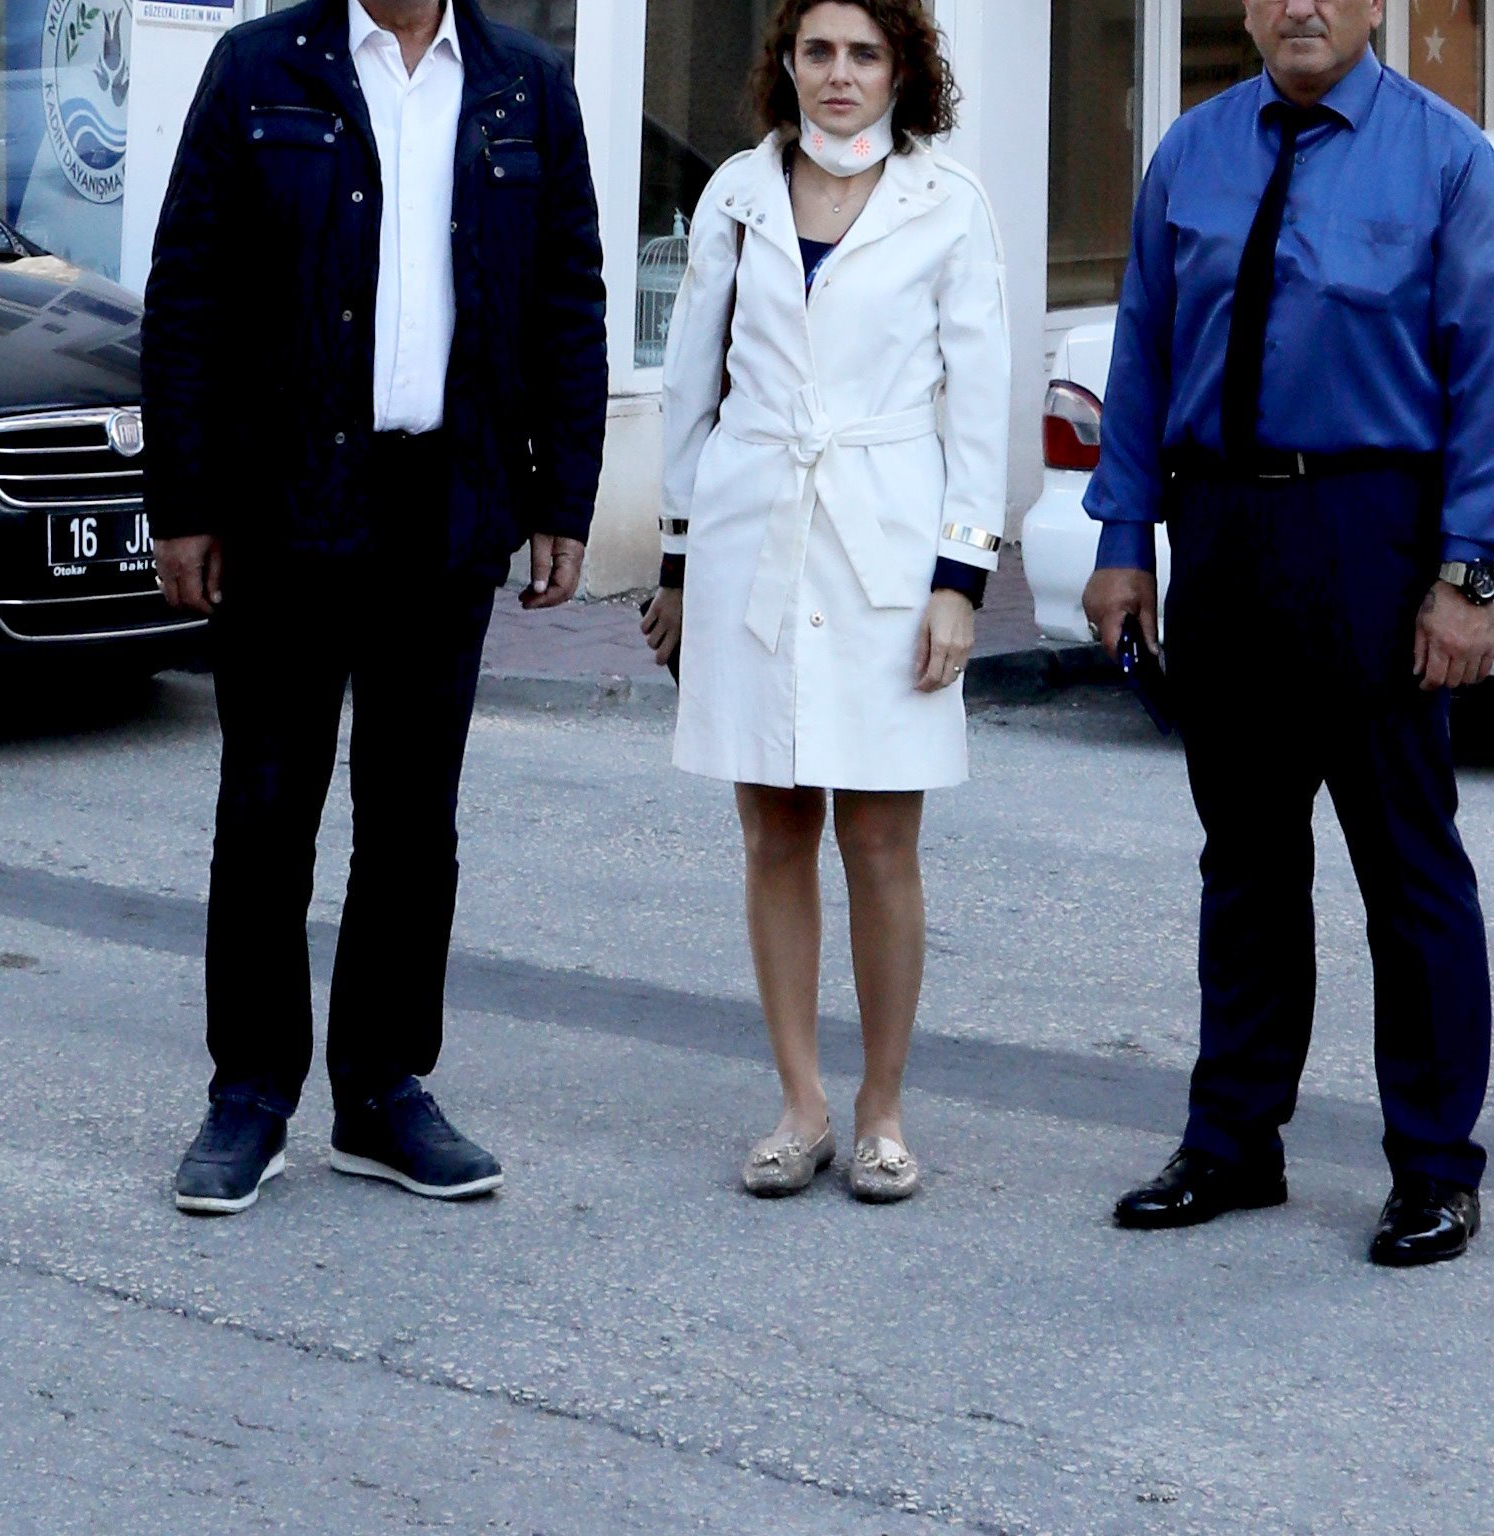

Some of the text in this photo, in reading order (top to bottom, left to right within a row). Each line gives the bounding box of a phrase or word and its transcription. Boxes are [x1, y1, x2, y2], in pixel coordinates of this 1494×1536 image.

[44, 81, 123, 201] KADIN DAYANIŞMA
[69, 517, 98, 558] 16
[53, 564, 87, 577] Otokar
